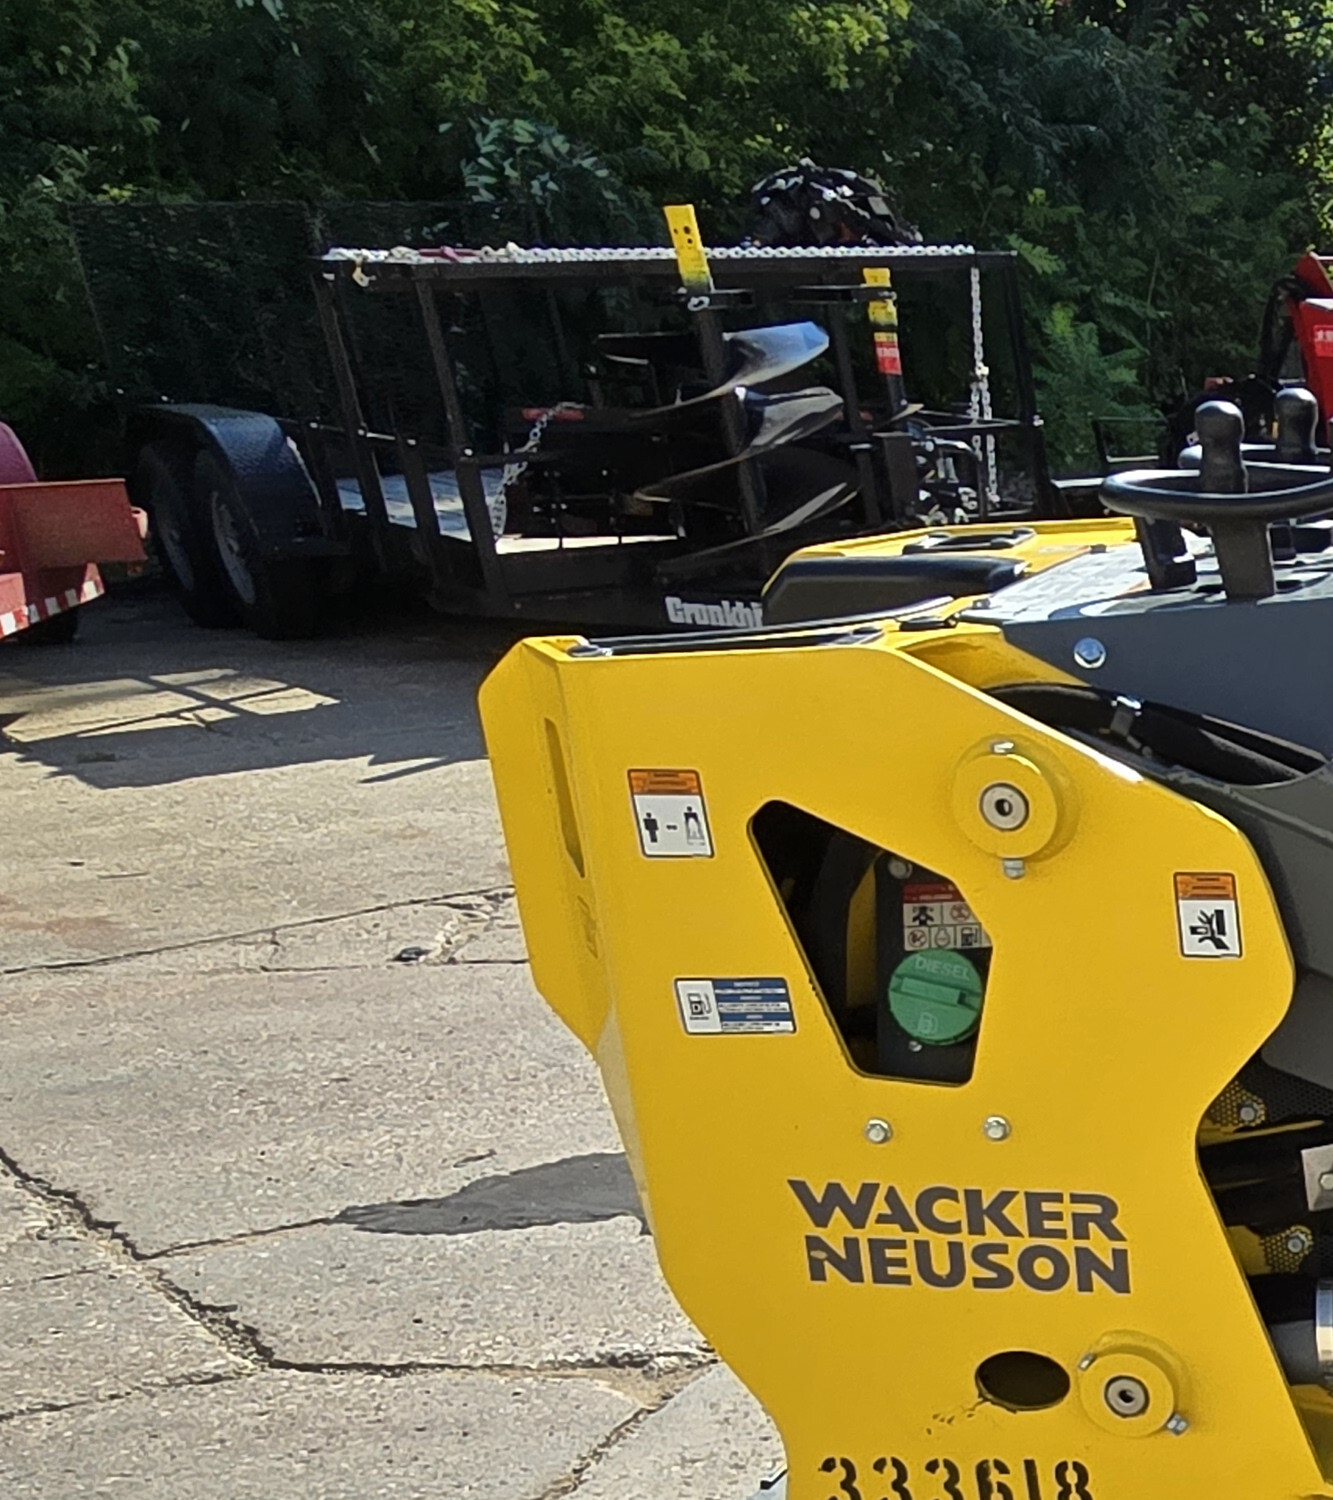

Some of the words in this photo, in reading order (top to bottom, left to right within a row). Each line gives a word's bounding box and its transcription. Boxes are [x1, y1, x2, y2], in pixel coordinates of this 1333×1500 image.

[665, 596, 763, 628] Cronkhi
[914, 956, 970, 981] DIESEL
[787, 1179, 1128, 1242] WACKER
[805, 1235, 1132, 1294] NEUSON
